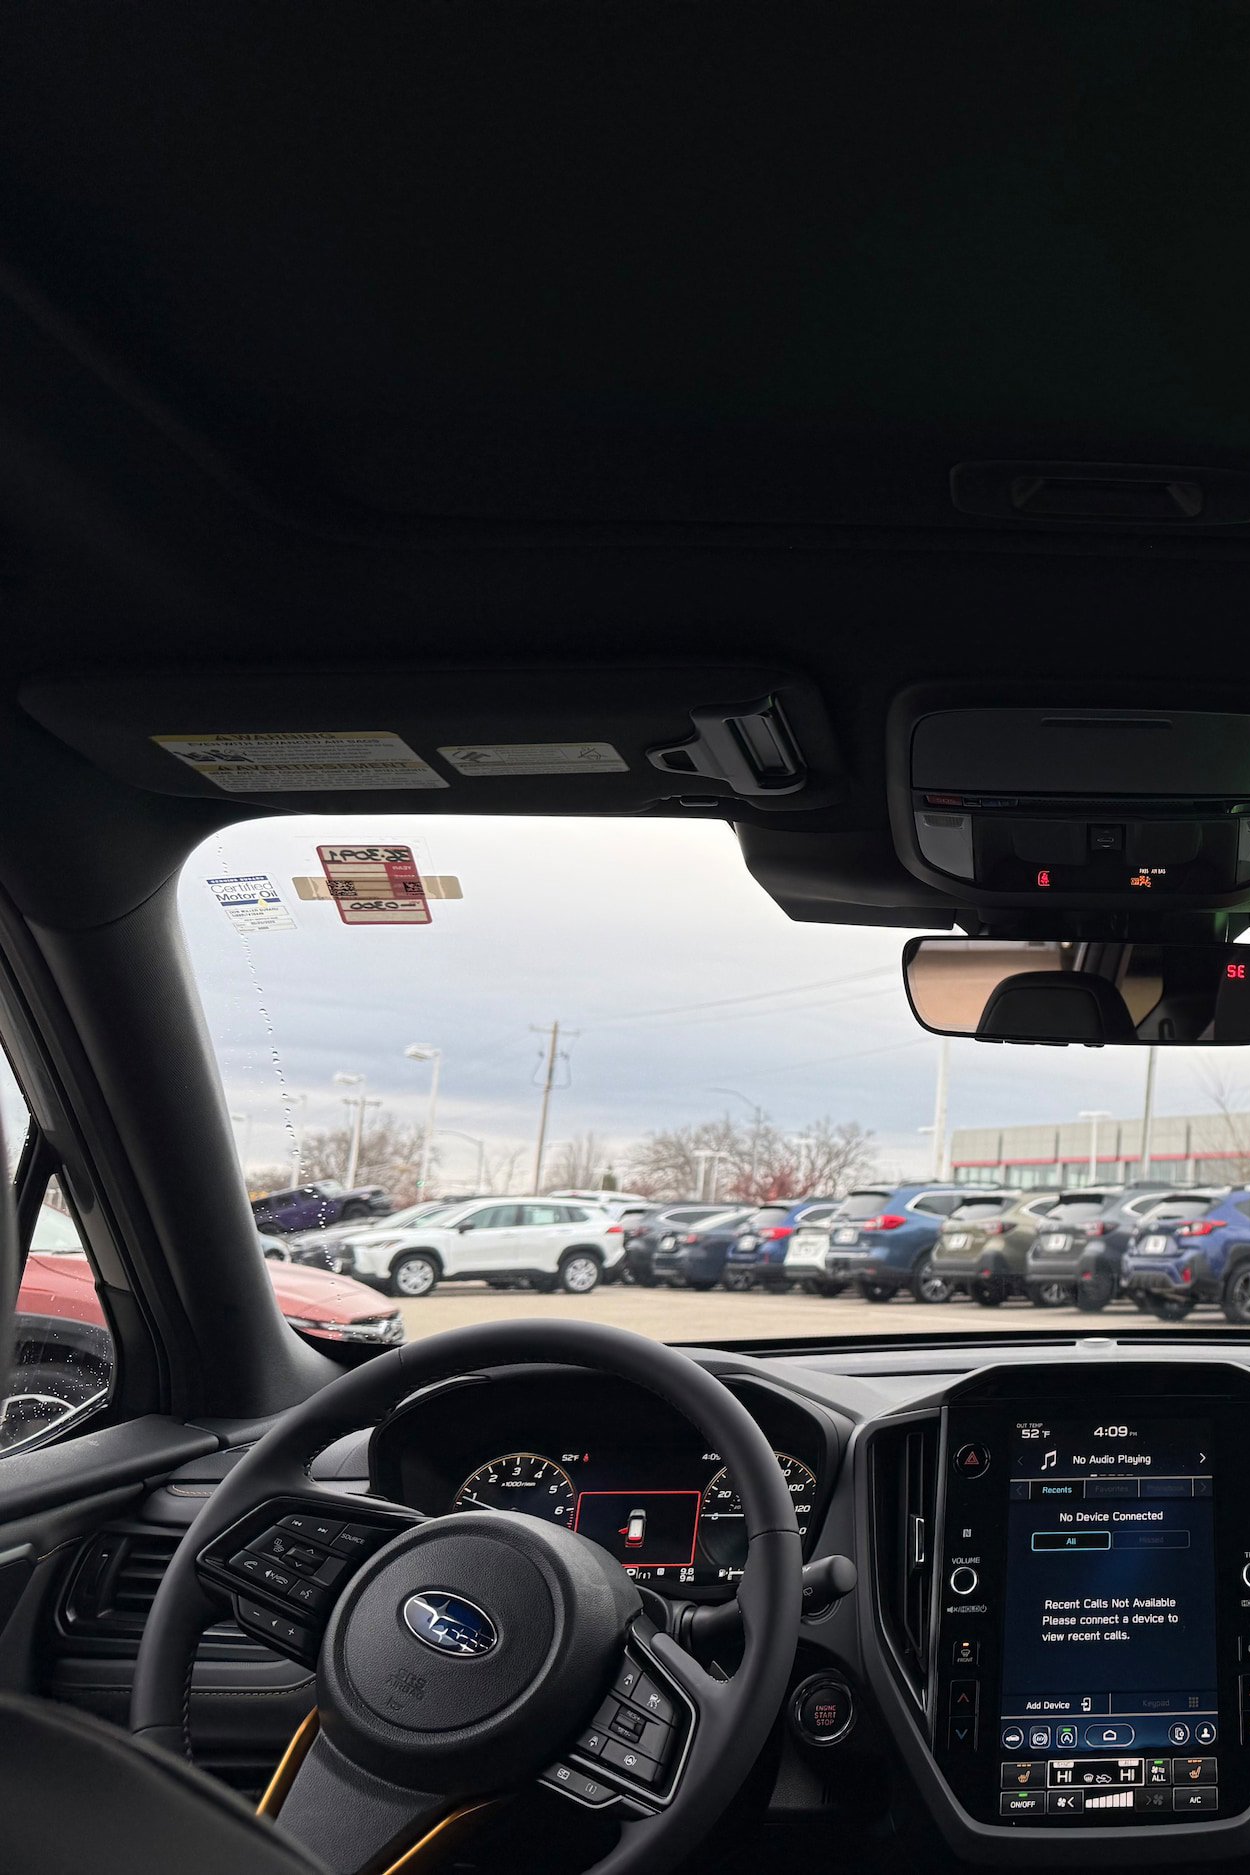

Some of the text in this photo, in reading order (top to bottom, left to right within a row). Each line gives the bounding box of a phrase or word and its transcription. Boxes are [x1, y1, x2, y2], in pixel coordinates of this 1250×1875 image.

[230, 733, 335, 741] WARNING
[235, 761, 408, 771] AVERTISSEMENT
[210, 881, 274, 893] Certified
[215, 890, 278, 901] Motor Oil
[1227, 964, 1245, 978] SE
[1021, 1429, 1039, 1439] 52
[1094, 1426, 1128, 1437] 4:09
[1073, 1454, 1152, 1465] No Audio Playing
[512, 1467, 521, 1476] 3
[534, 1470, 544, 1479] 4
[488, 1474, 498, 1483] 2
[548, 1485, 558, 1494] 5
[718, 1490, 732, 1498] 20
[1042, 1486, 1072, 1494] Recents
[472, 1492, 478, 1500] 1
[554, 1506, 564, 1515] 6
[1060, 1511, 1163, 1522] No Device Connected
[341, 1533, 365, 1544] SOURCE
[1066, 1537, 1077, 1545] All
[1045, 1598, 1176, 1610] Recent Calls Not Available
[1042, 1614, 1178, 1626] Please connect a device to
[1042, 1631, 1130, 1642] view recent calls.
[1026, 1701, 1070, 1710] Add Device
[1057, 1773, 1072, 1783] HI
[1120, 1771, 1135, 1781] HI
[1152, 1774, 1166, 1782] ALL
[1190, 1796, 1202, 1804] A/C
